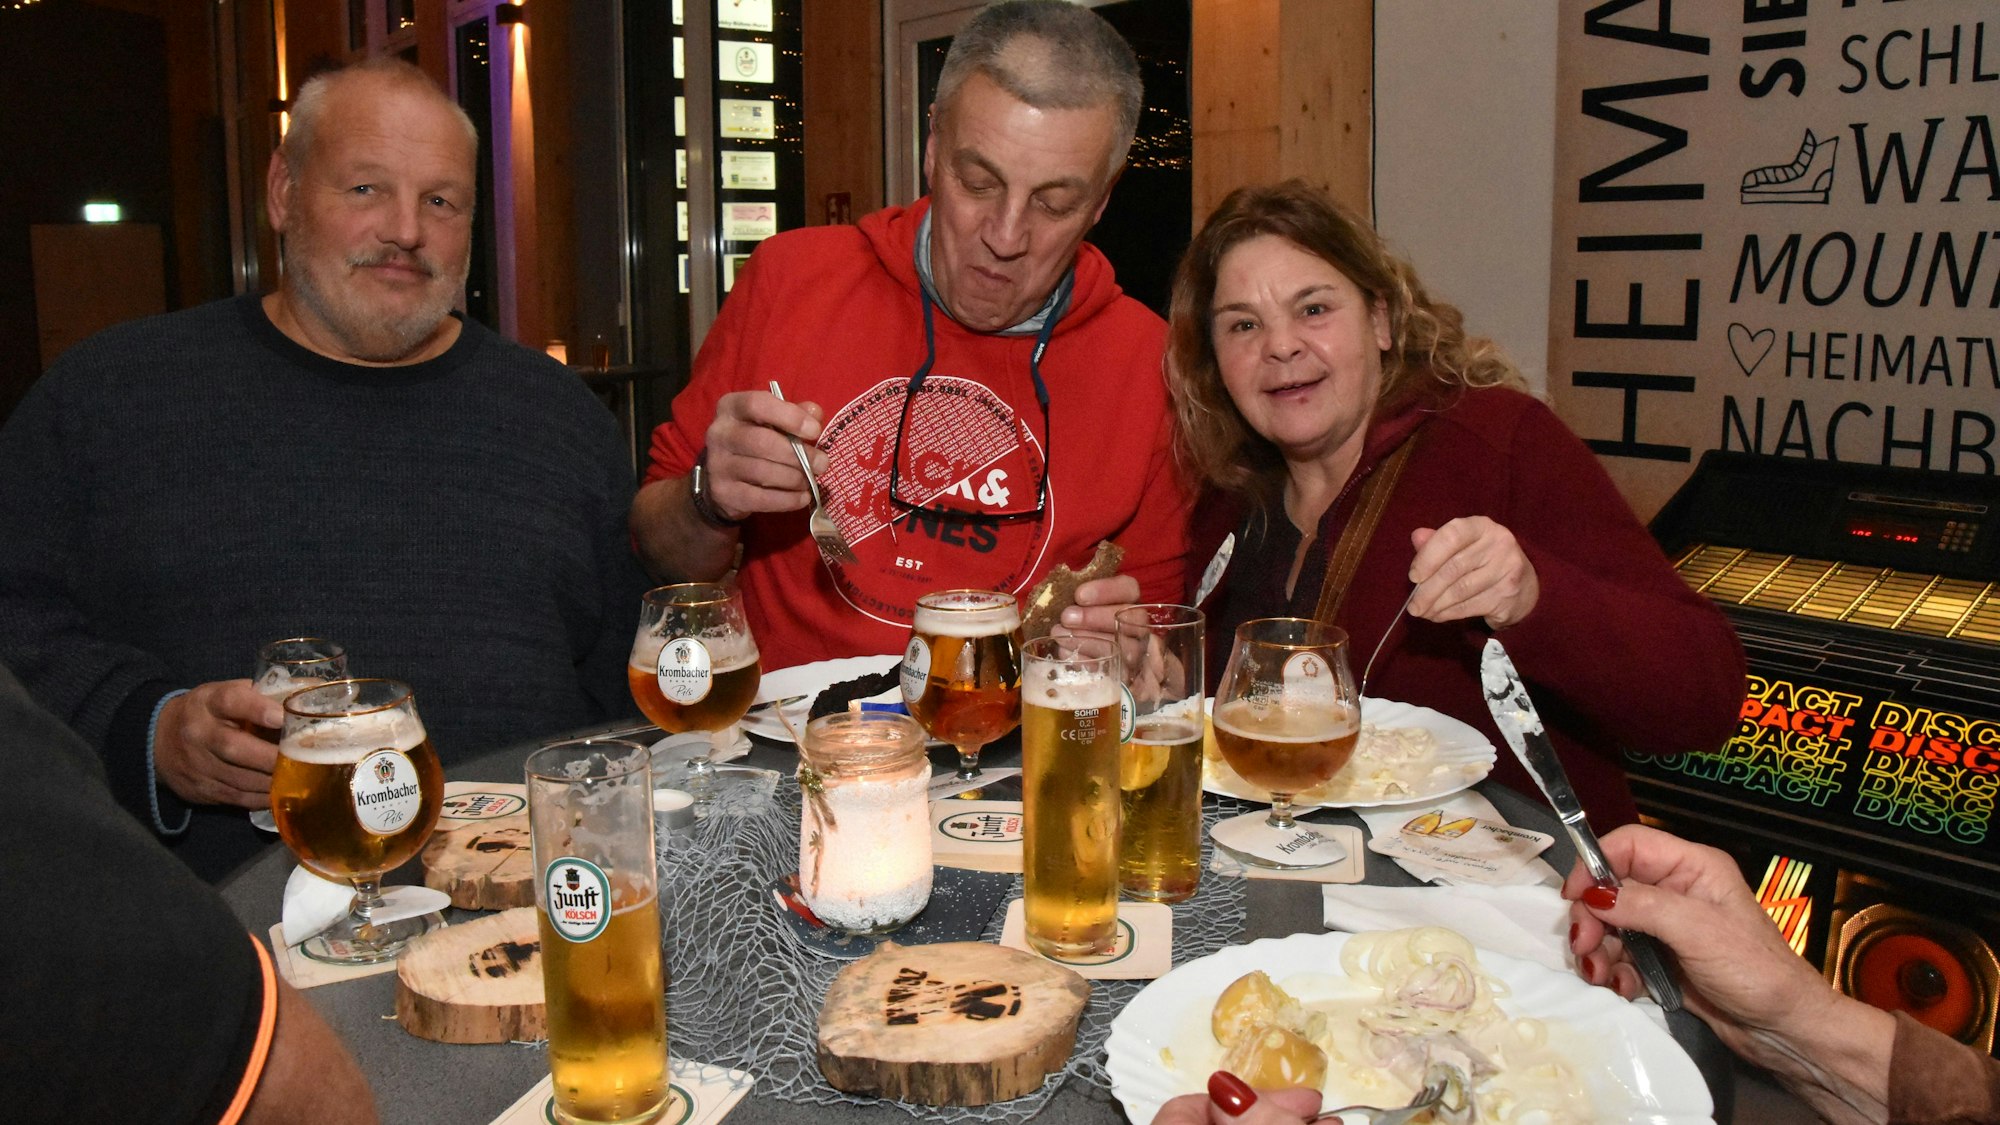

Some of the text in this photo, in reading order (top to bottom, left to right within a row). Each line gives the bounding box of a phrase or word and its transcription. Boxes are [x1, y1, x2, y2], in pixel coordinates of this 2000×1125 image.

[1838, 22, 1999, 94] SCHL
[1848, 115, 2000, 205] WA
[896, 556, 924, 570] EST
[659, 665, 709, 679] Krombacher
[672, 685, 693, 697] Pils
[1870, 701, 2000, 746] DISC
[1869, 725, 2000, 774] DISC
[1863, 749, 2000, 800] DISC
[356, 782, 418, 807] Krombacher
[1858, 769, 1995, 822] DISC
[378, 810, 404, 827] Pils
[1853, 789, 1988, 844] DISC
[1480, 824, 1542, 843] Krombacher
[553, 884, 600, 910] Zunft
[565, 908, 597, 920] KÖLSCH
